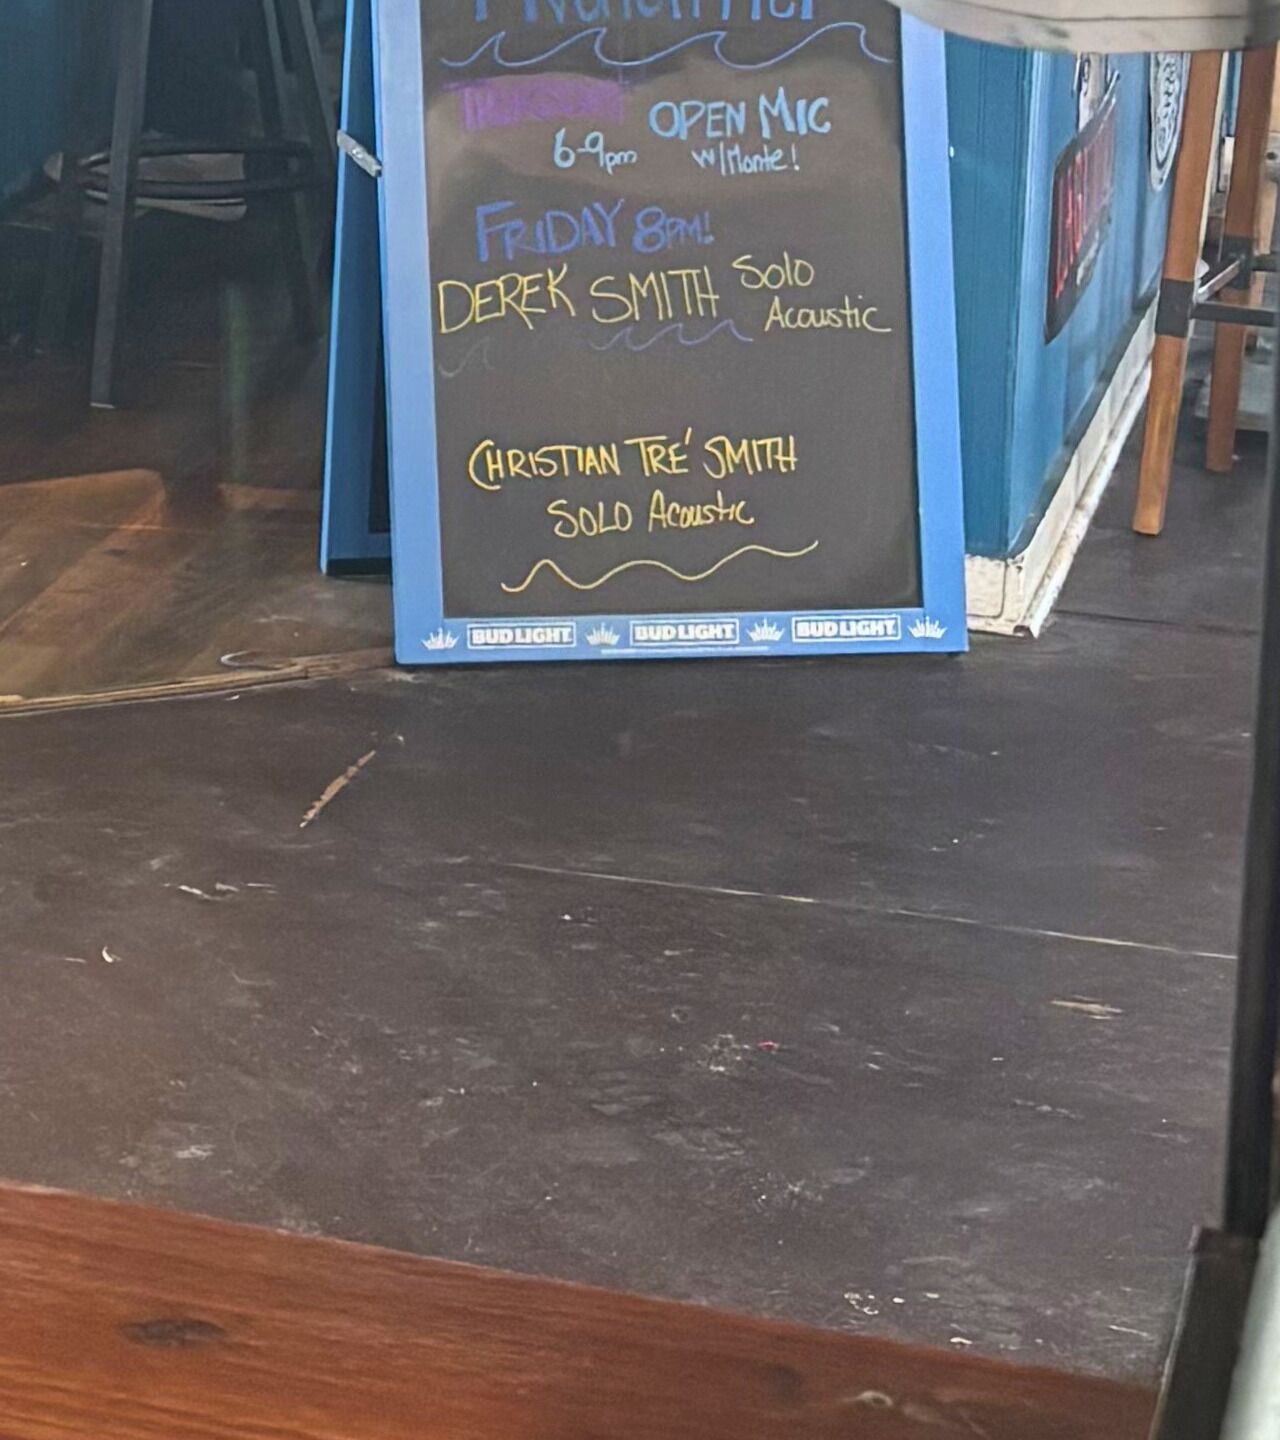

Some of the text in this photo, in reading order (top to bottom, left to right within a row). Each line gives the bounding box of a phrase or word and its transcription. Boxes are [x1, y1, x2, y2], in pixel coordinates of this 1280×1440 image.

[648, 100, 746, 140] OPEN
[758, 86, 832, 139] MIC
[475, 198, 625, 262] FRIDAY
[732, 251, 814, 288] Solo
[438, 263, 720, 334] DEREK SMITH
[764, 295, 892, 333] Acoustic
[468, 439, 621, 490] CHRISTIAN
[702, 435, 798, 479] SMITH
[547, 489, 755, 538] SOLO Acoustic
[471, 627, 572, 644] BUD LIGHT
[634, 623, 735, 641] BUD LIGHT
[796, 619, 896, 637] BUD LIGHT
